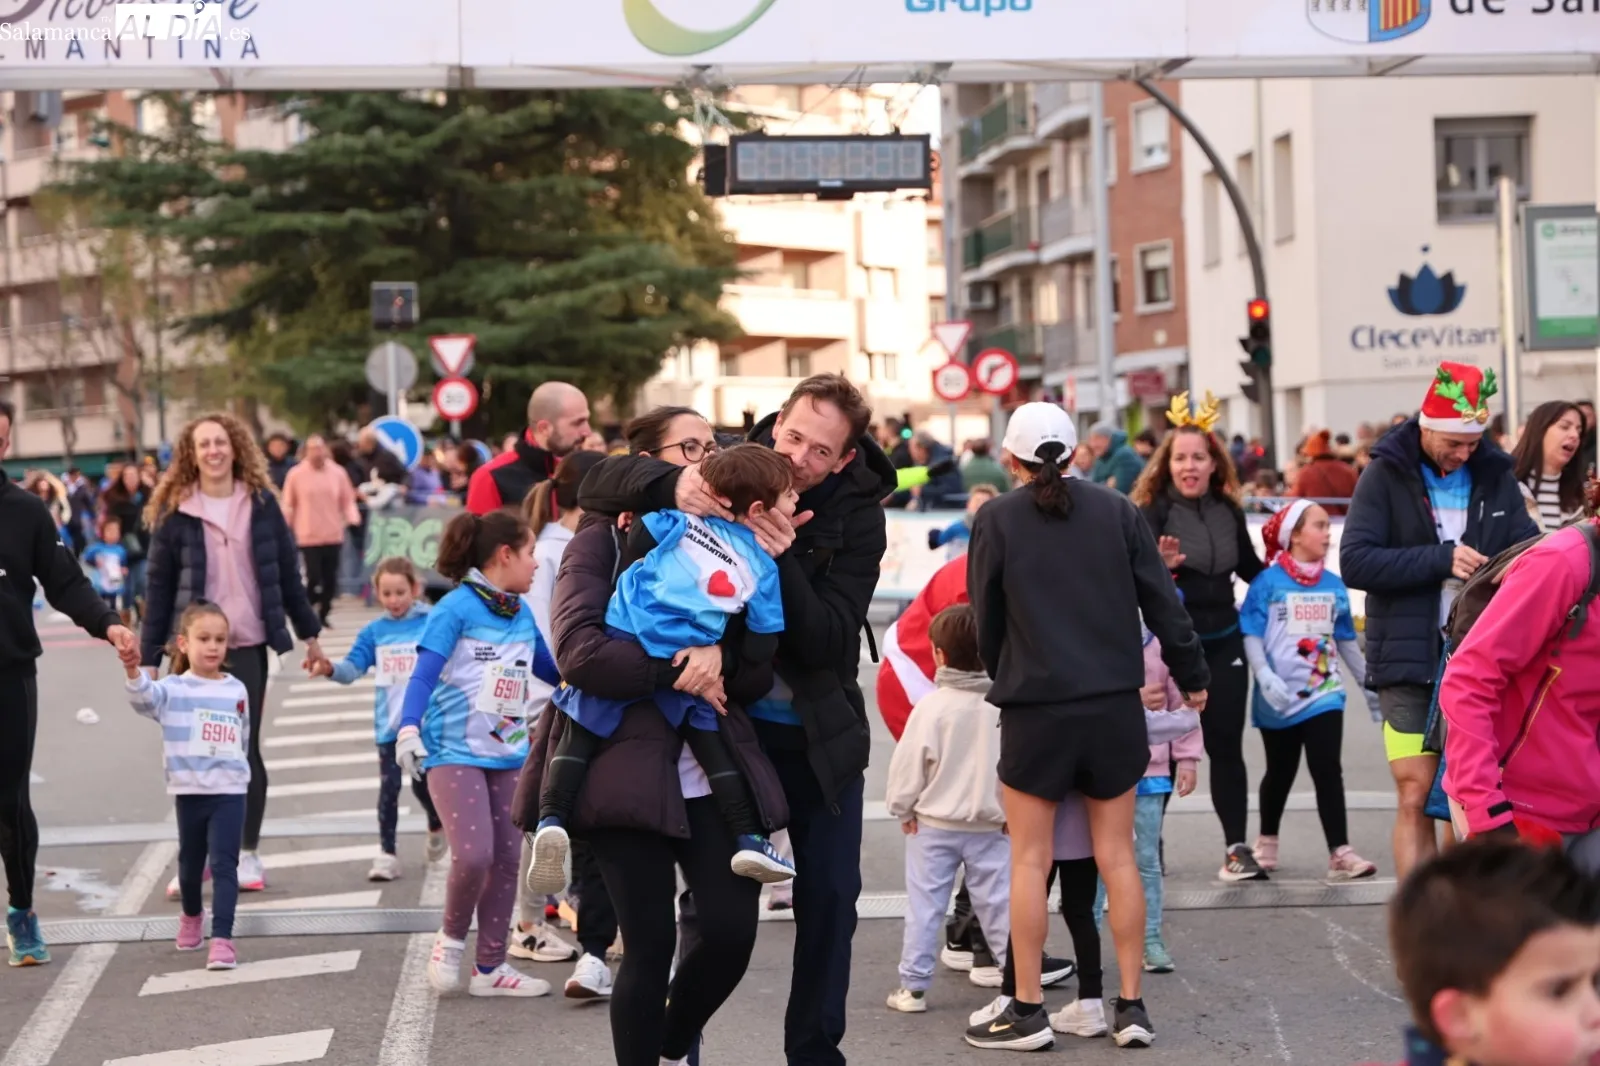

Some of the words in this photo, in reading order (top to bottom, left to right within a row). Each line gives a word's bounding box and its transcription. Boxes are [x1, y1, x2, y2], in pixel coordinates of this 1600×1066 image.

[0, 36, 259, 59] MANTINA
[1295, 604, 1328, 620] 6680
[494, 678, 522, 700] 6911
[202, 722, 236, 743] 6914
